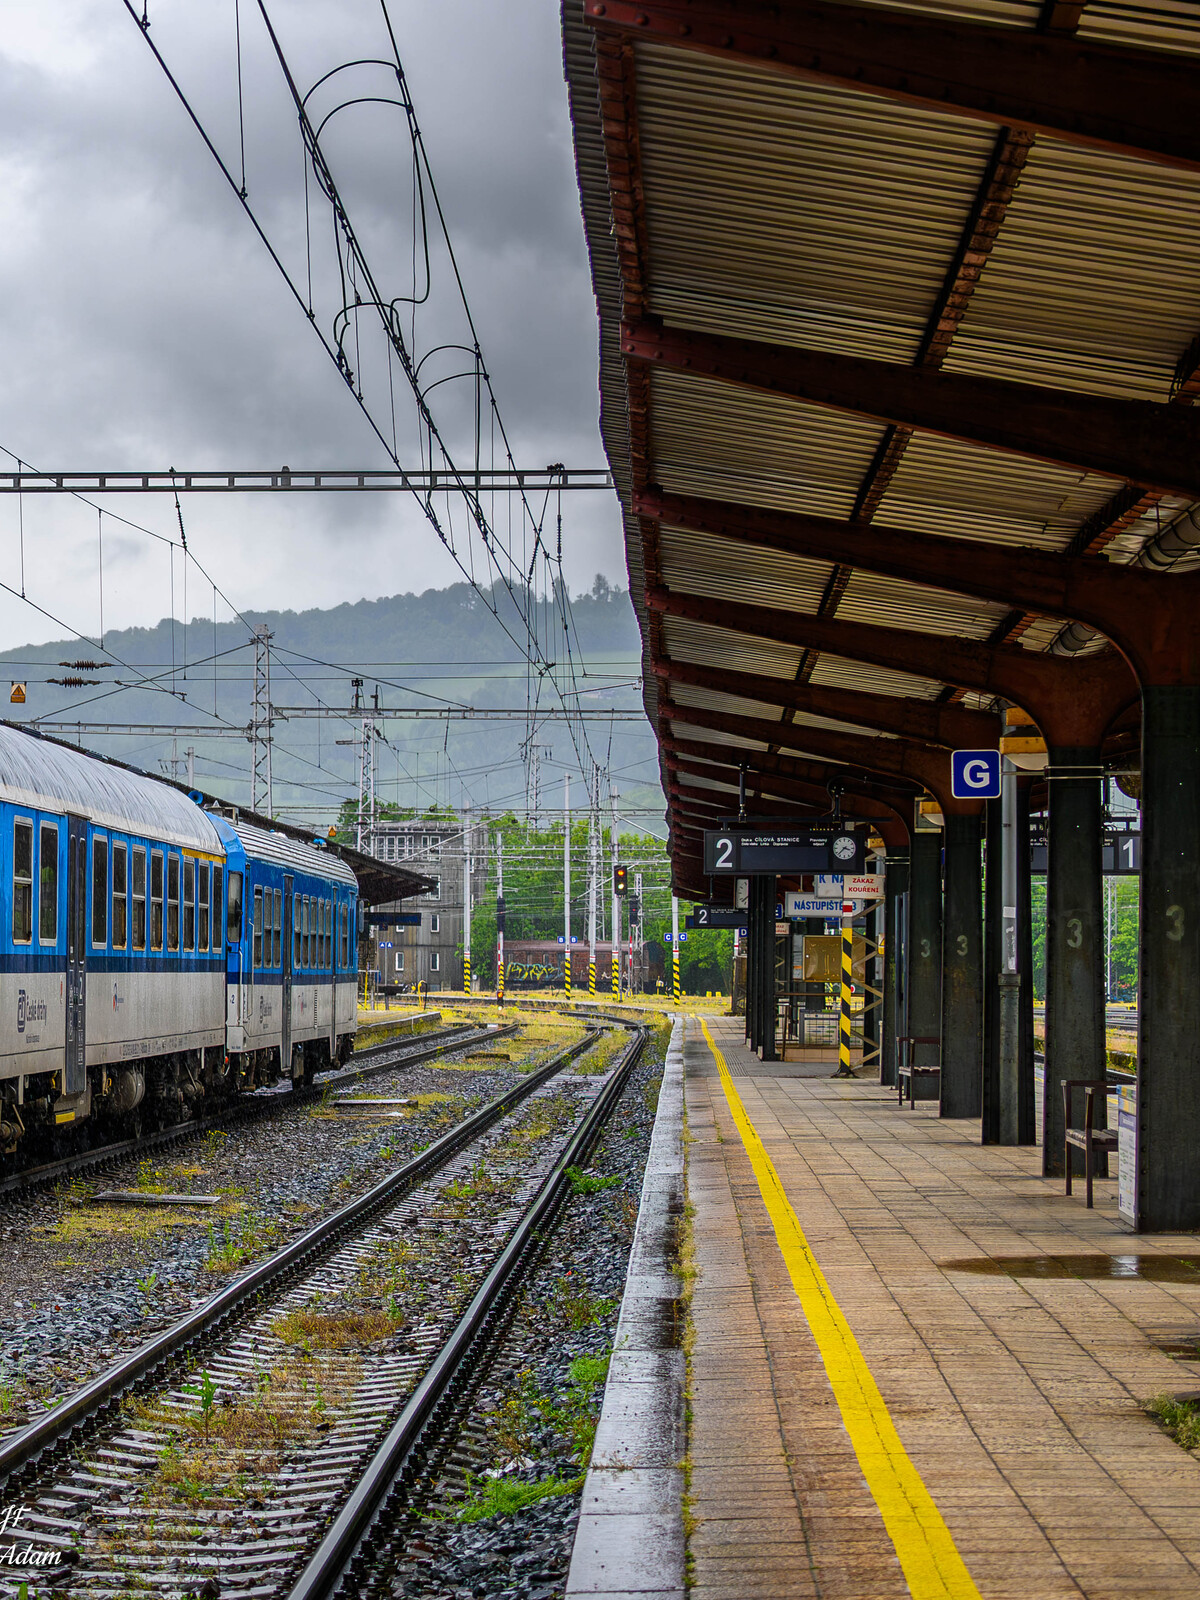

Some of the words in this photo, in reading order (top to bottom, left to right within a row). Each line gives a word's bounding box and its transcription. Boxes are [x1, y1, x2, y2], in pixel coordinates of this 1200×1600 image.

[963, 760, 990, 788] G
[715, 838, 733, 868] 2
[1122, 838, 1134, 868] 1
[848, 885, 879, 893] KOUŘENÍ
[698, 909, 708, 924] 2
[1166, 904, 1185, 941] 3
[957, 935, 968, 956] 3
[1066, 918, 1083, 948] 3
[921, 939, 931, 957] 3
